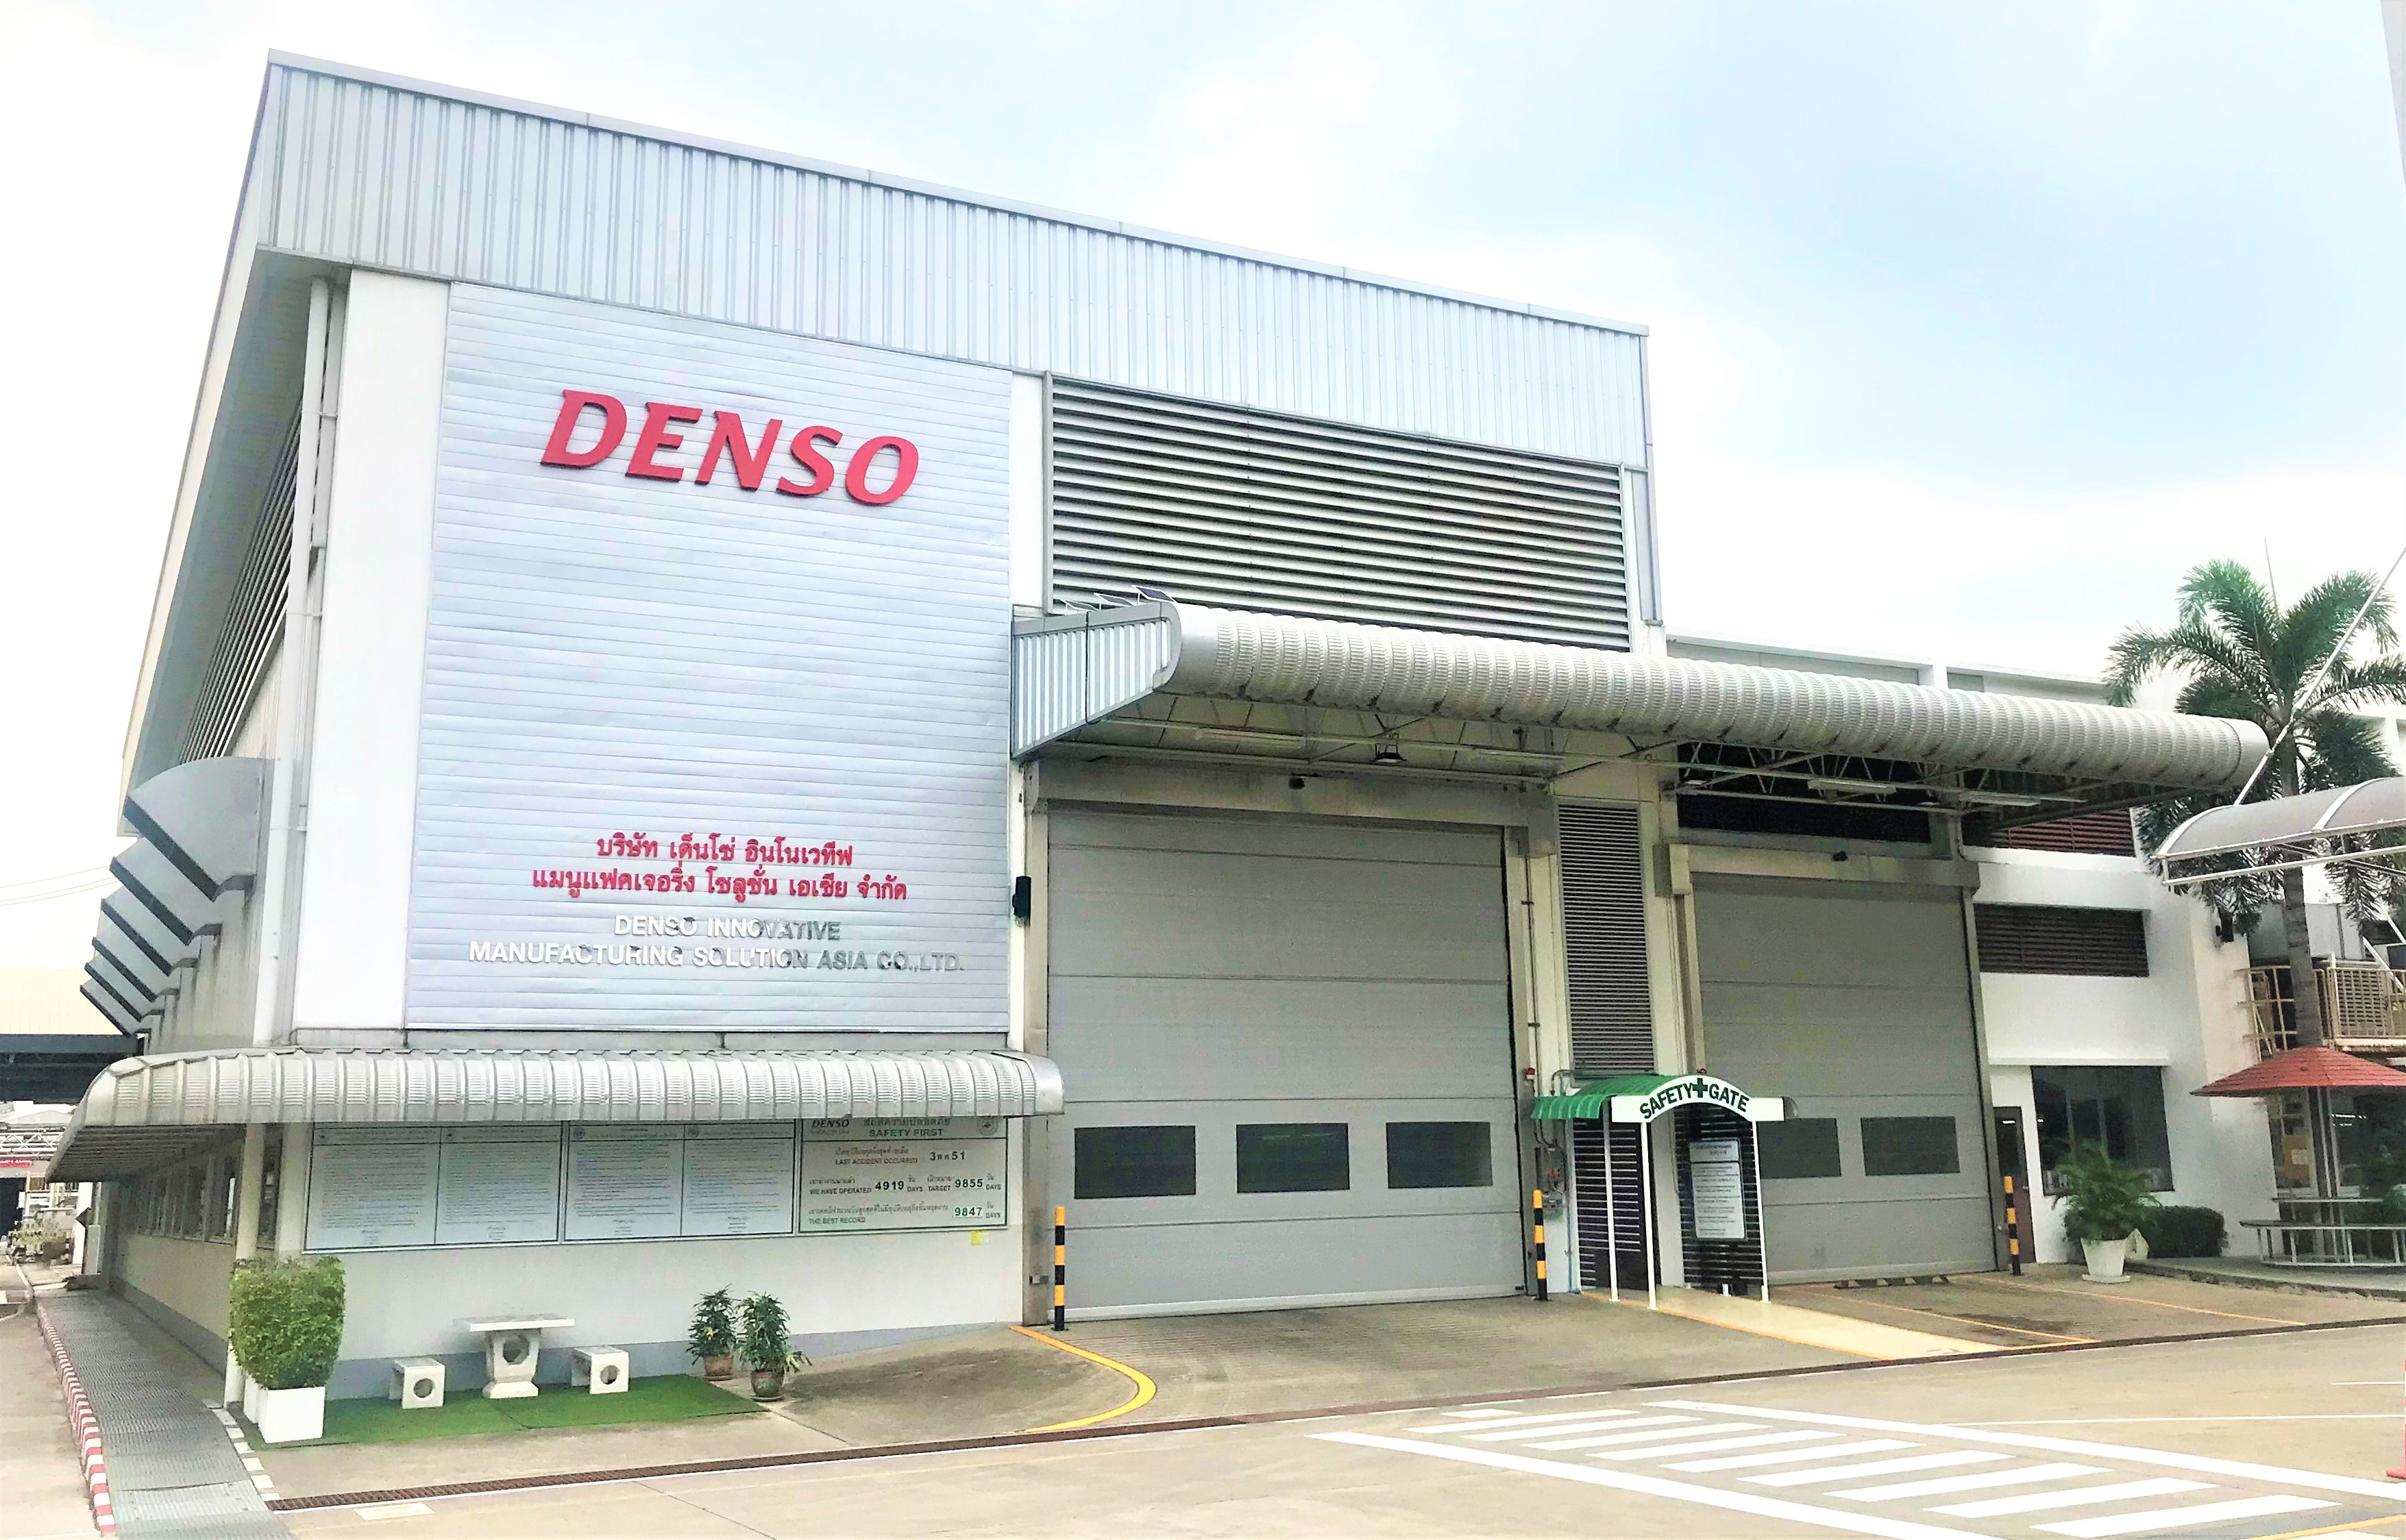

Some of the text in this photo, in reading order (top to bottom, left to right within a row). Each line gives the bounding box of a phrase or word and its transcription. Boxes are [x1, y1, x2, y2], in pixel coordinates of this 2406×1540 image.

[540, 388, 920, 507] DENSO
[597, 832, 853, 866] บริษัท เด็นโซ่ อินโนเวทีฟ
[532, 861, 907, 903] แมนูแฟคเจอริ่ง โซลูชั่น เอเชีย จำกัด
[614, 915, 841, 942] DENSO INNOVATIVE
[469, 941, 684, 968] MANUFACTURING
[693, 945, 808, 970] SOLUTION
[815, 949, 868, 971] ASIA
[1639, 1082, 1750, 1119] SAFETY GATE
[812, 1119, 850, 1128] DENSO
[868, 1128, 944, 1137] SAFETY FIRST
[875, 1180, 905, 1191] 4919
[955, 1178, 983, 1188] 9855
[955, 1206, 983, 1217] 9847
